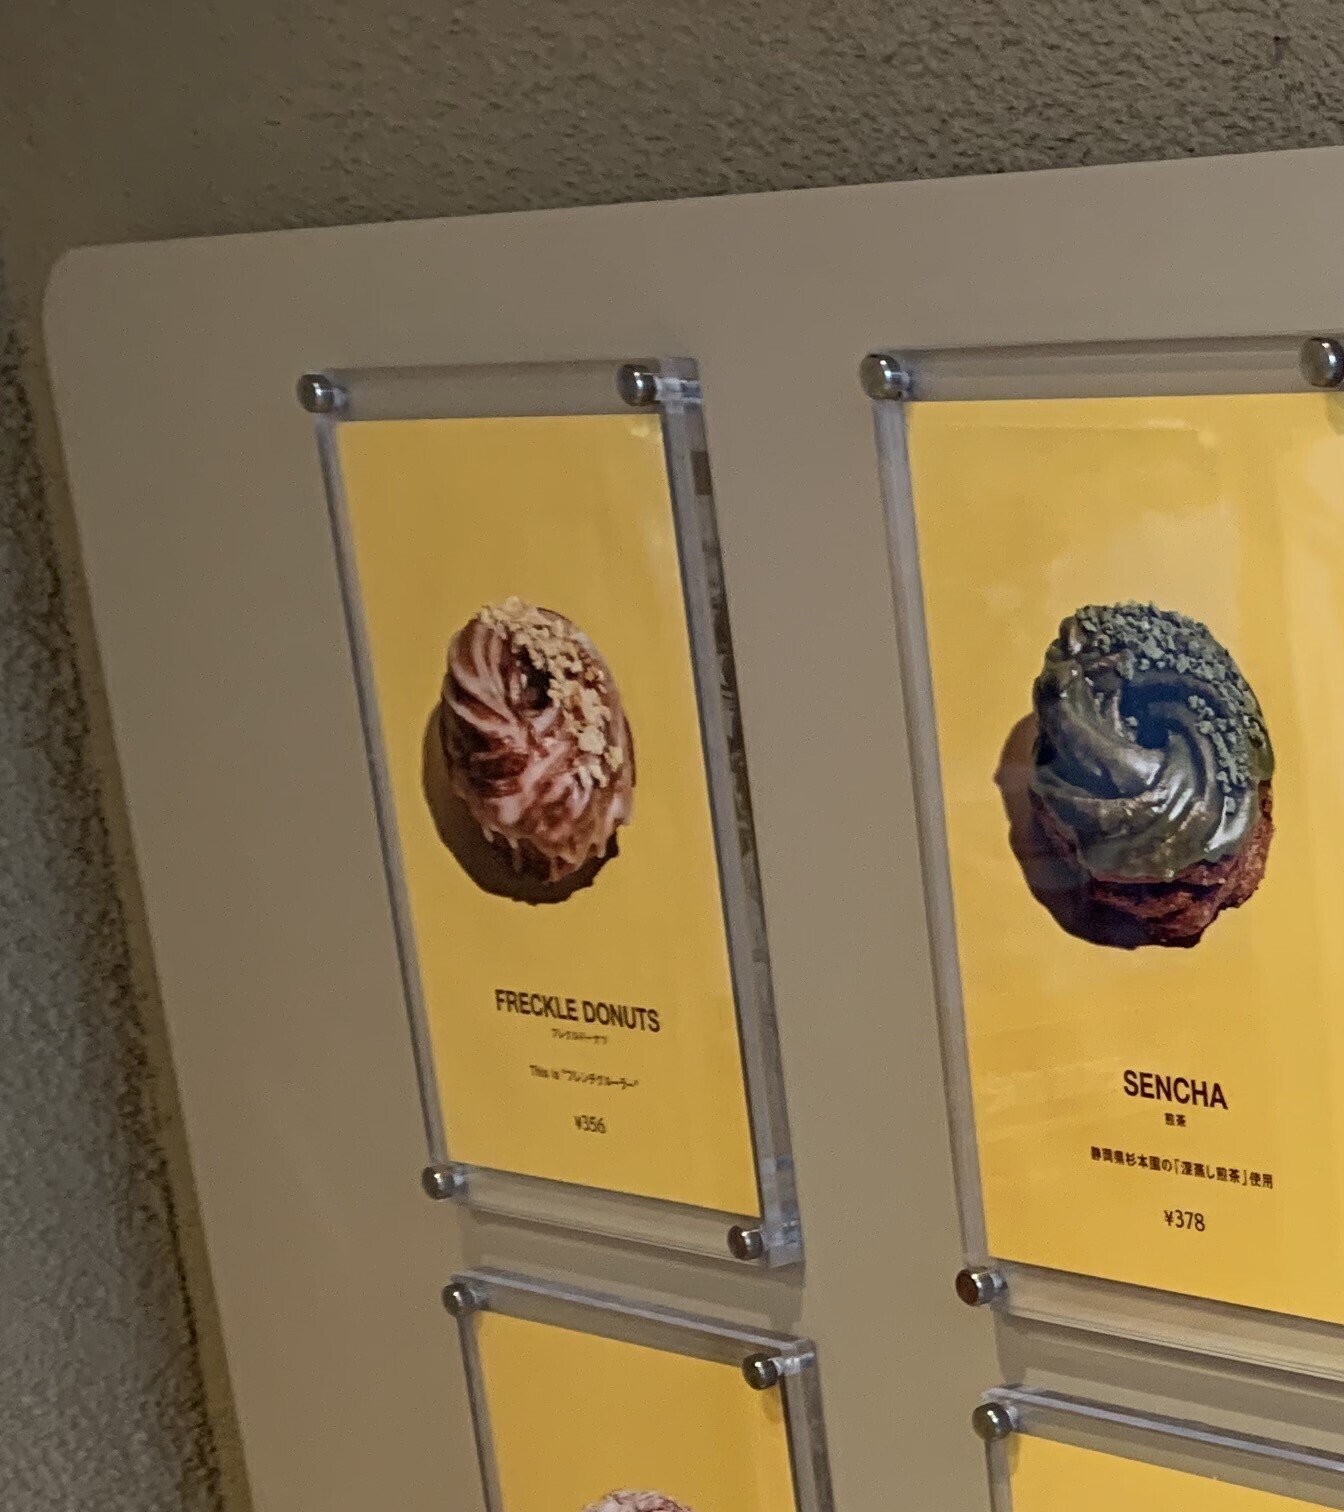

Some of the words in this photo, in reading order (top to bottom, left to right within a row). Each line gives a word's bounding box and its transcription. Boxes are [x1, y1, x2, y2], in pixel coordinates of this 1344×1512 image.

[495, 989, 579, 1021] FRECKLE
[582, 1000, 661, 1033] DONUTS
[1123, 1069, 1229, 1110] SENCHA
[1164, 1209, 1205, 1232] ¥378
